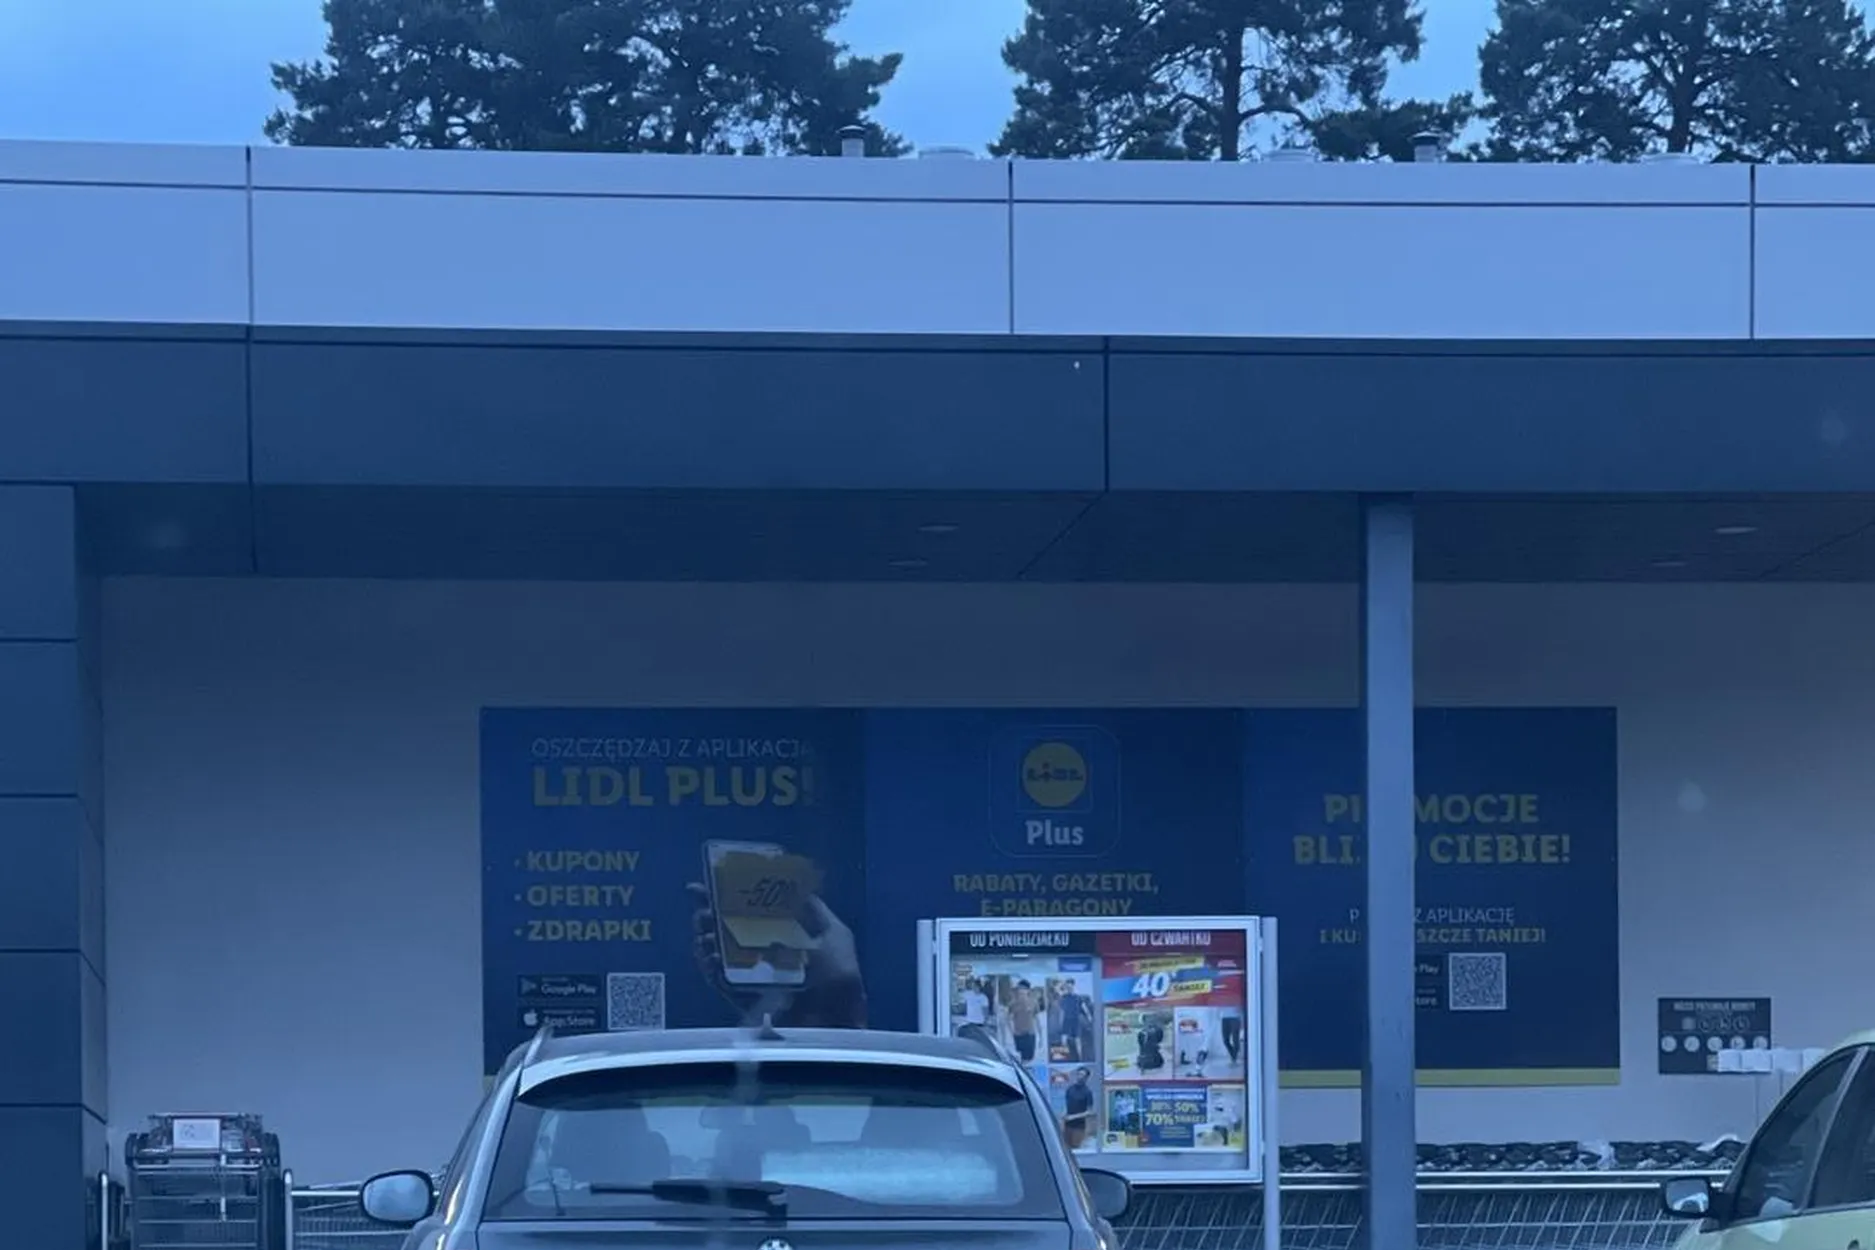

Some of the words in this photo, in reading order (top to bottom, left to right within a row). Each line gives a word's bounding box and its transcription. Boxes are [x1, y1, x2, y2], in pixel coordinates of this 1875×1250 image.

[531, 737, 671, 762] OSZCZĘDZAJ
[677, 738, 692, 758] Z
[532, 766, 655, 806] LIDL
[1323, 794, 1540, 823] PMOCJE
[1024, 819, 1084, 846] Plus
[1429, 834, 1571, 864] CIEBIE!
[527, 851, 640, 872] KUPONY
[953, 874, 1048, 895] RABATY,
[1052, 874, 1159, 895] GAZETKI,
[527, 885, 635, 907] OFERTY
[981, 898, 1133, 916] E-PARAGONY
[527, 920, 652, 941] ZDRAPKI
[970, 932, 987, 947] OD
[541, 983, 576, 996] Google
[577, 983, 598, 995] Play
